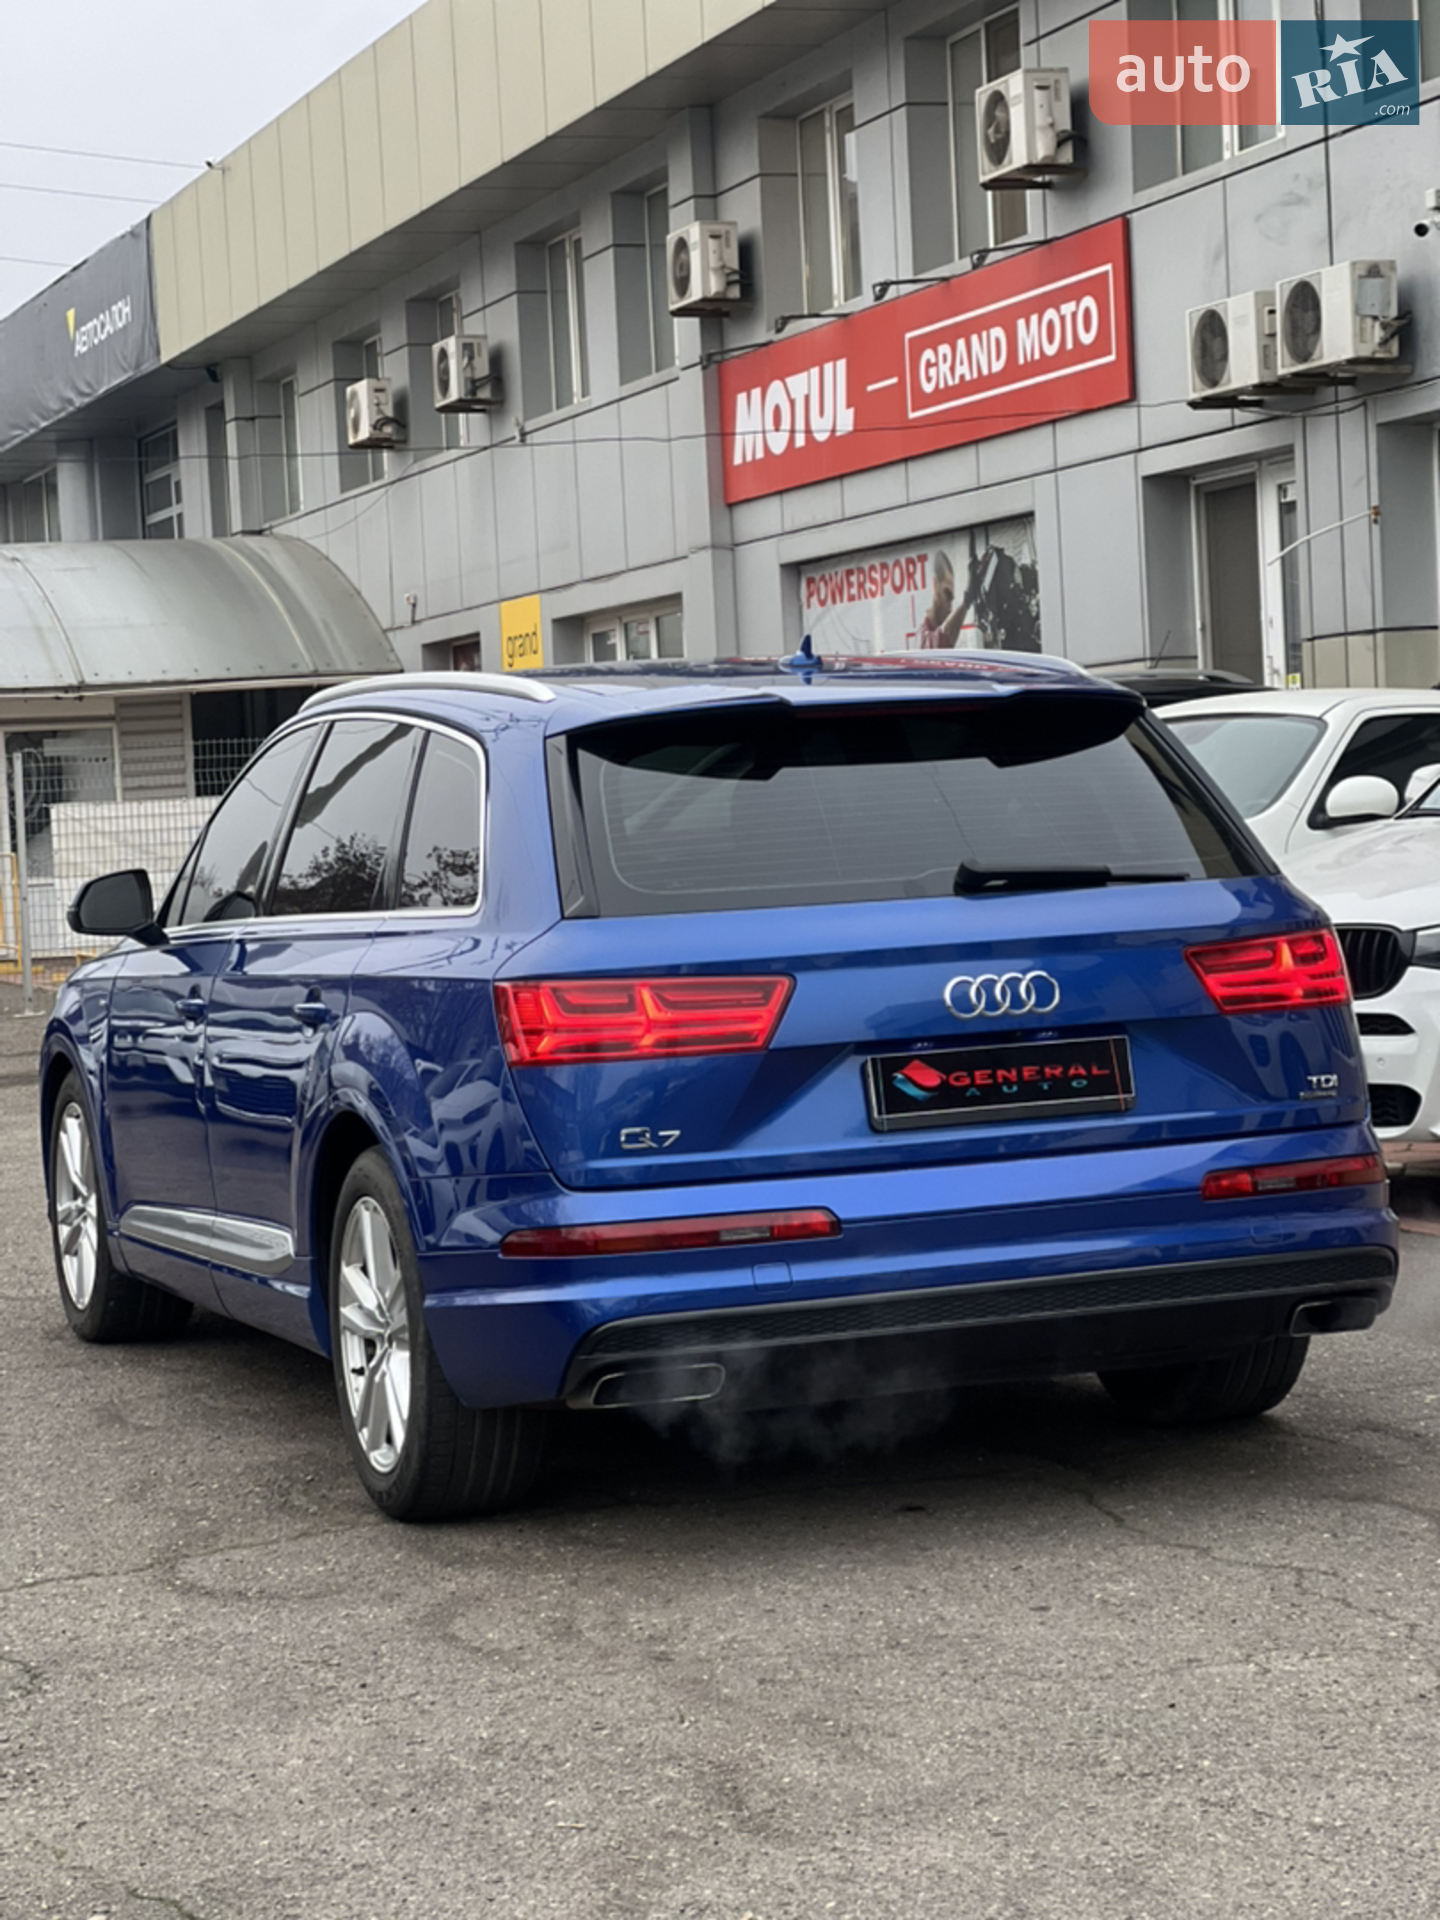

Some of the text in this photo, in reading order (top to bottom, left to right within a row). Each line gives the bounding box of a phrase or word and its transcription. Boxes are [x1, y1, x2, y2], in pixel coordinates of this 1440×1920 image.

[74, 294, 132, 357] АВТОСАЛОН
[732, 295, 1099, 466] MOTUL GRAND MOTO
[804, 553, 929, 609] POWERSPORT
[506, 622, 539, 669] grand
[948, 1062, 1111, 1087] GENERAL
[965, 1078, 1089, 1097] AUTO
[1306, 1074, 1338, 1089] TDI
[620, 1126, 681, 1150] Q7
